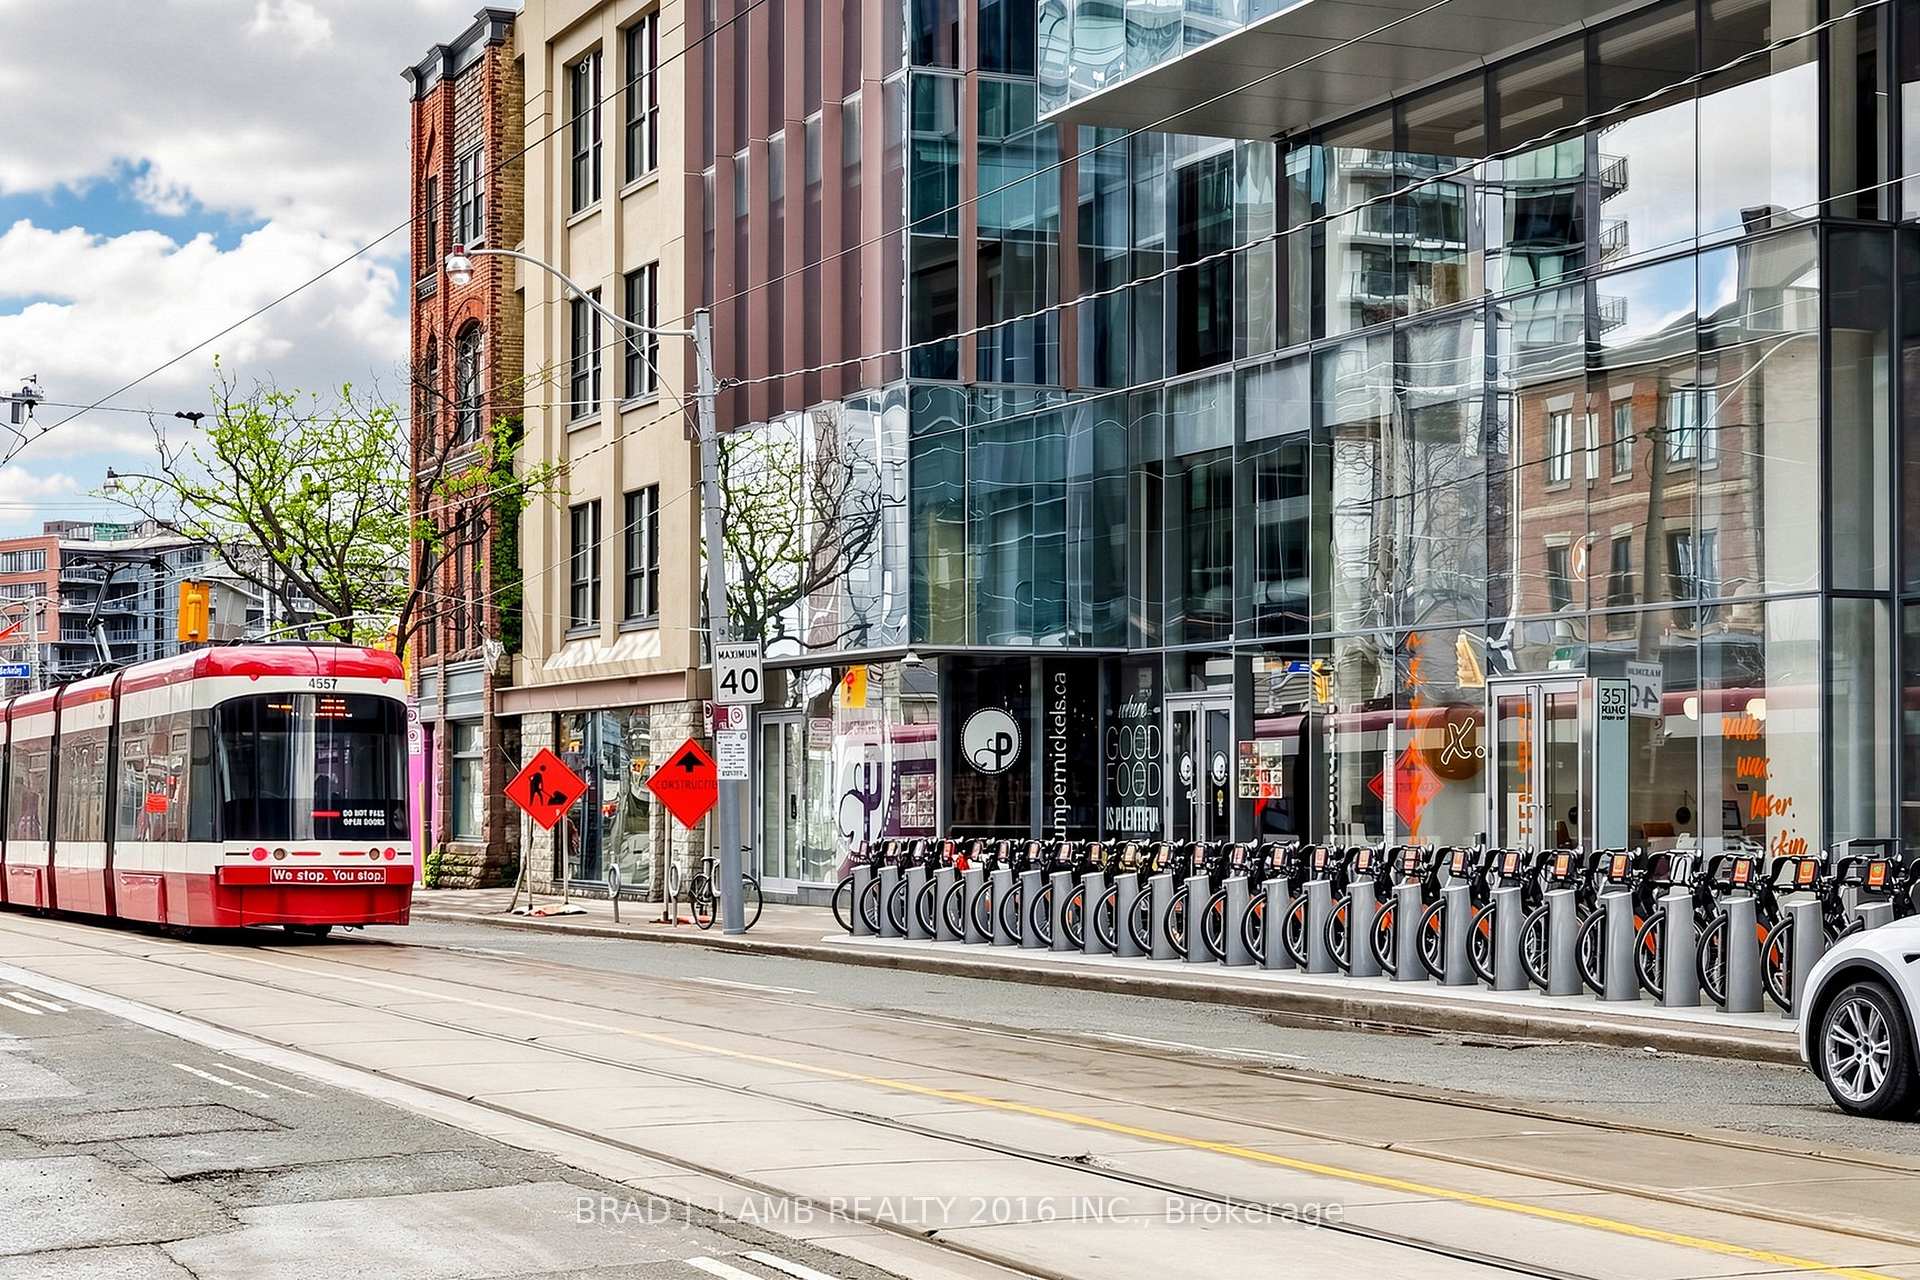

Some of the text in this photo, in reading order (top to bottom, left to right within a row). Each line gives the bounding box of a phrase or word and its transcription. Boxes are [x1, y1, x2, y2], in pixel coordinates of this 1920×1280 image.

[718, 650, 758, 660] MAXIMUM
[308, 678, 338, 690] 4557
[720, 668, 759, 694] 40
[1601, 688, 1626, 705] 351
[1601, 705, 1626, 715] KING
[1106, 725, 1161, 760] GOOD
[1049, 672, 1071, 843] umpernickels.ca
[656, 779, 718, 791] CONSTRUCTIO
[1105, 761, 1161, 797] FOOD
[1105, 806, 1114, 831] IS
[273, 869, 385, 883] We stop. You stop.
